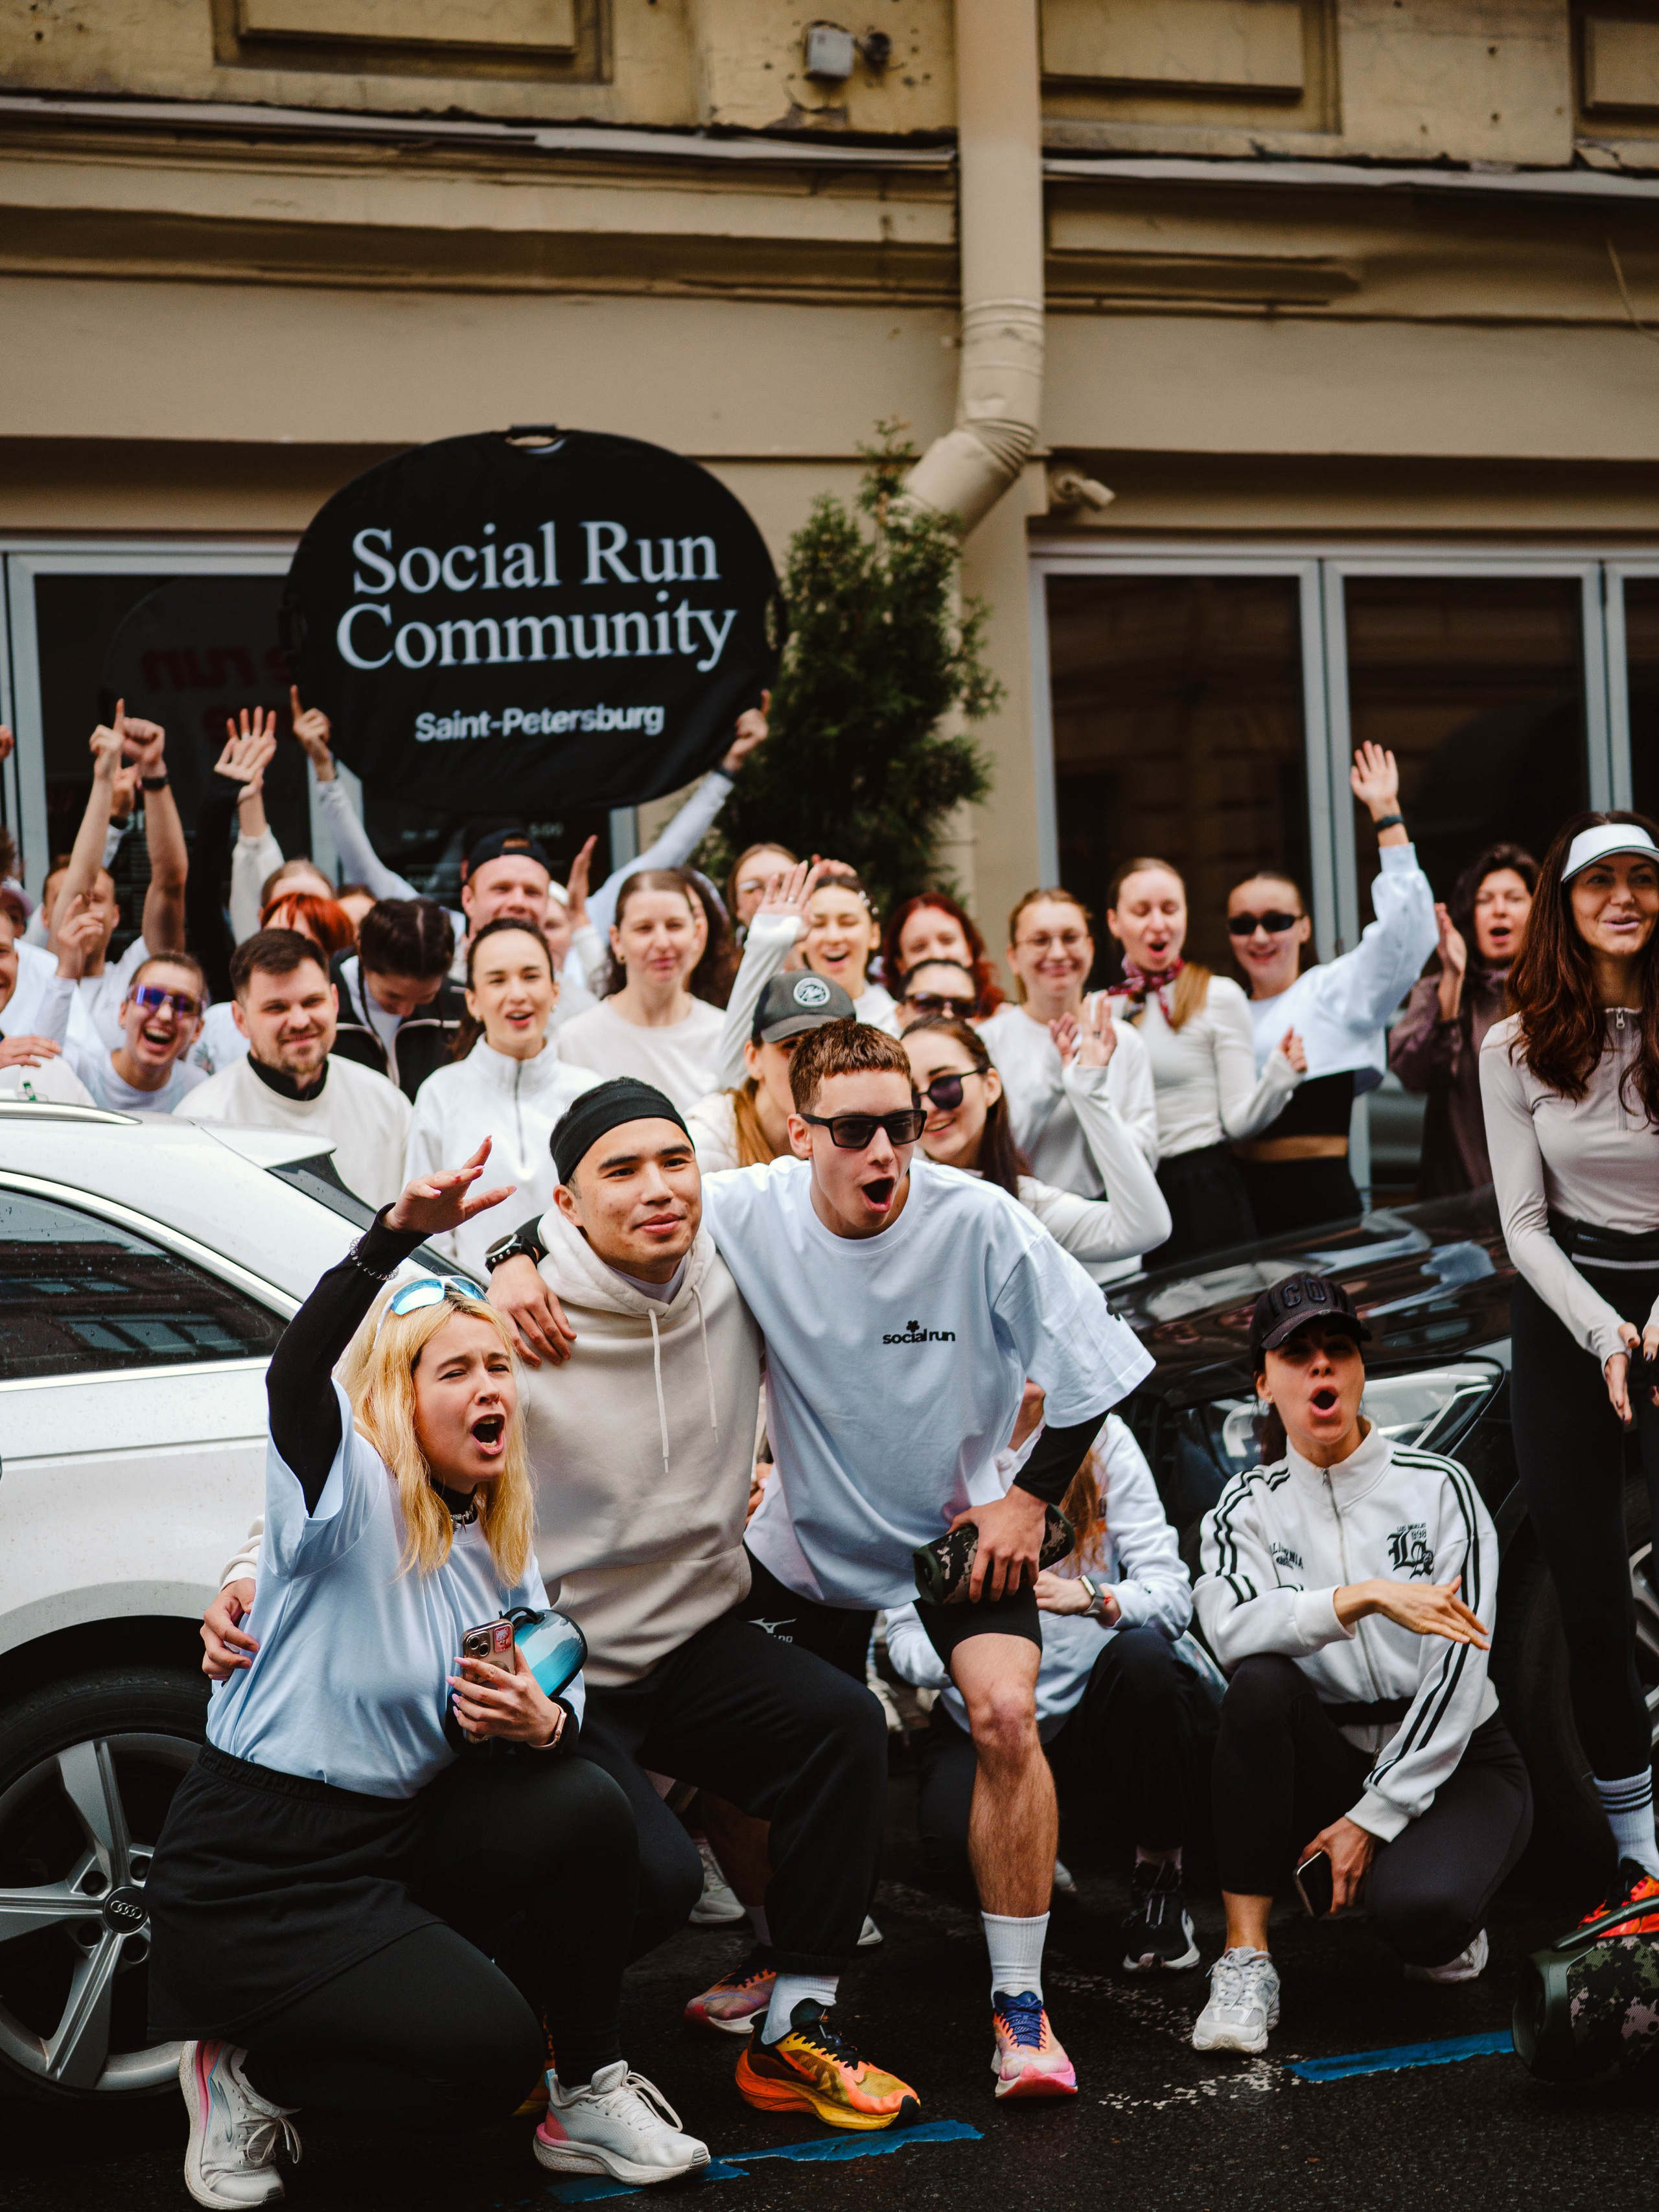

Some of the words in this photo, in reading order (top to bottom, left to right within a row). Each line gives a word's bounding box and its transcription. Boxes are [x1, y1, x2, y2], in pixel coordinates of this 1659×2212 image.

[351, 520, 562, 595] Social
[581, 520, 721, 585] Run
[336, 590, 739, 672] Community
[414, 703, 664, 742] Saint-Petersburg
[883, 1328, 927, 1344] social
[929, 1331, 956, 1342] run
